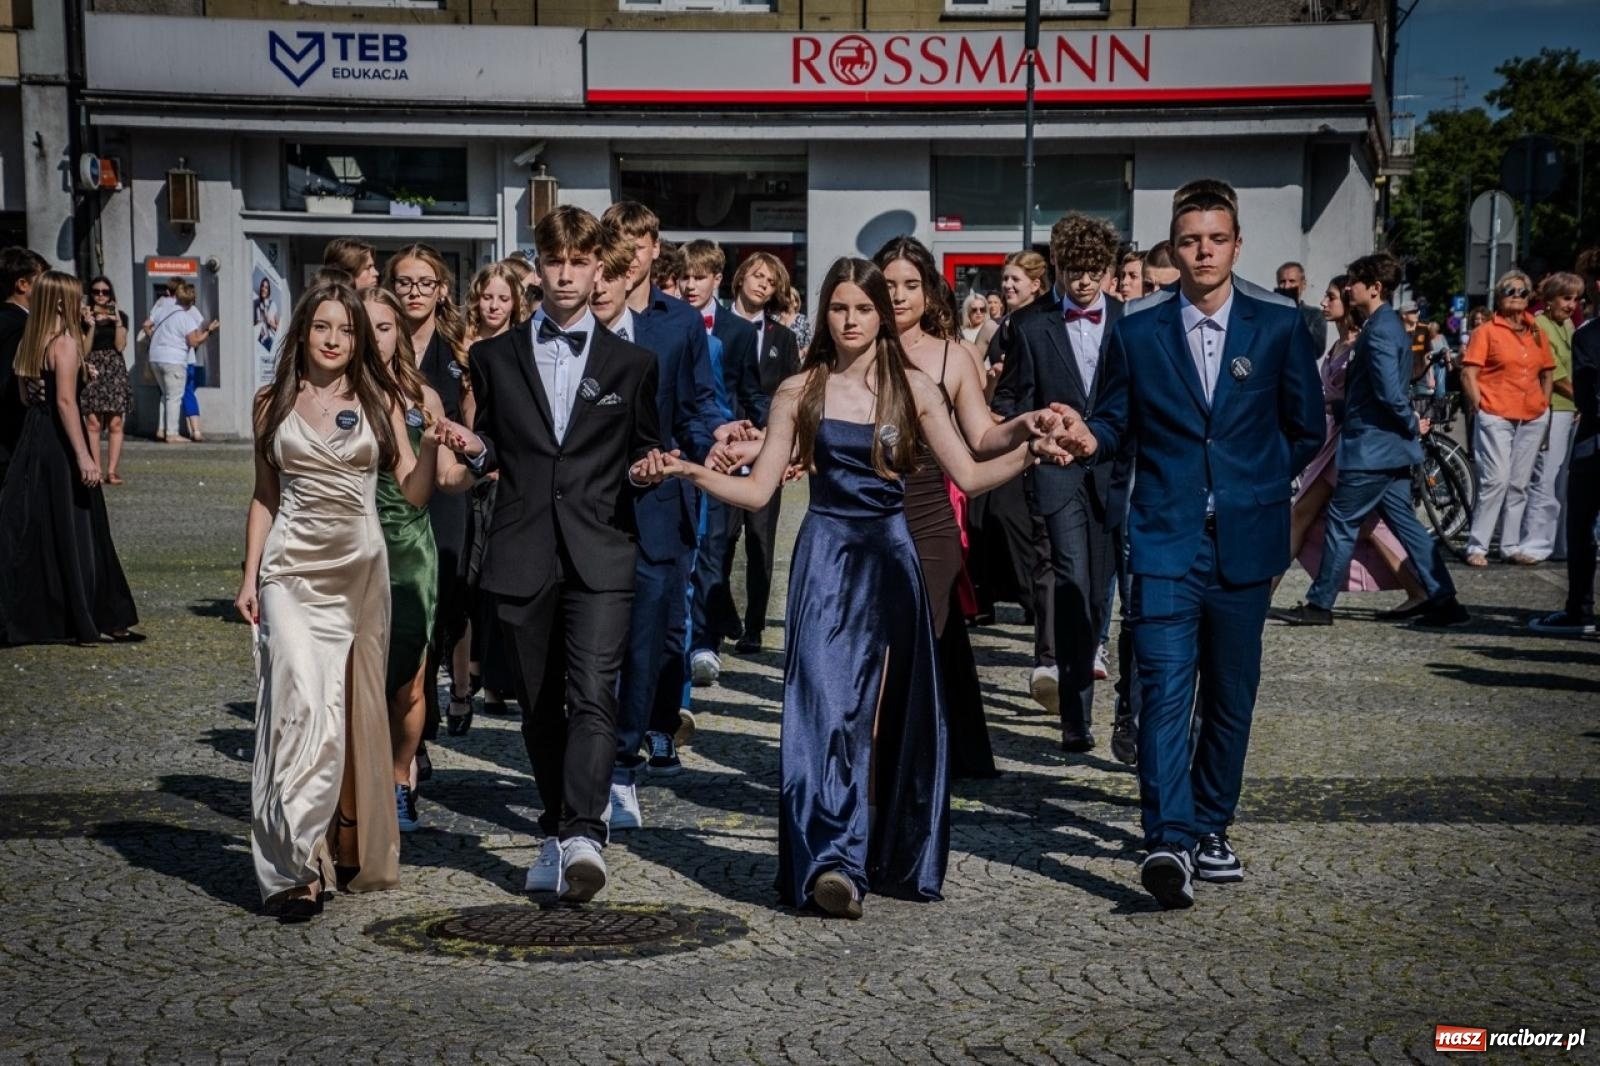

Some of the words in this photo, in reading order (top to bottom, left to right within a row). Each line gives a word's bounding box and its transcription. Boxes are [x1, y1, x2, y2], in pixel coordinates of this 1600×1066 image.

[331, 32, 408, 62] TEB
[792, 34, 1151, 85] ROSSMANN
[332, 67, 409, 80] EDUKACJA
